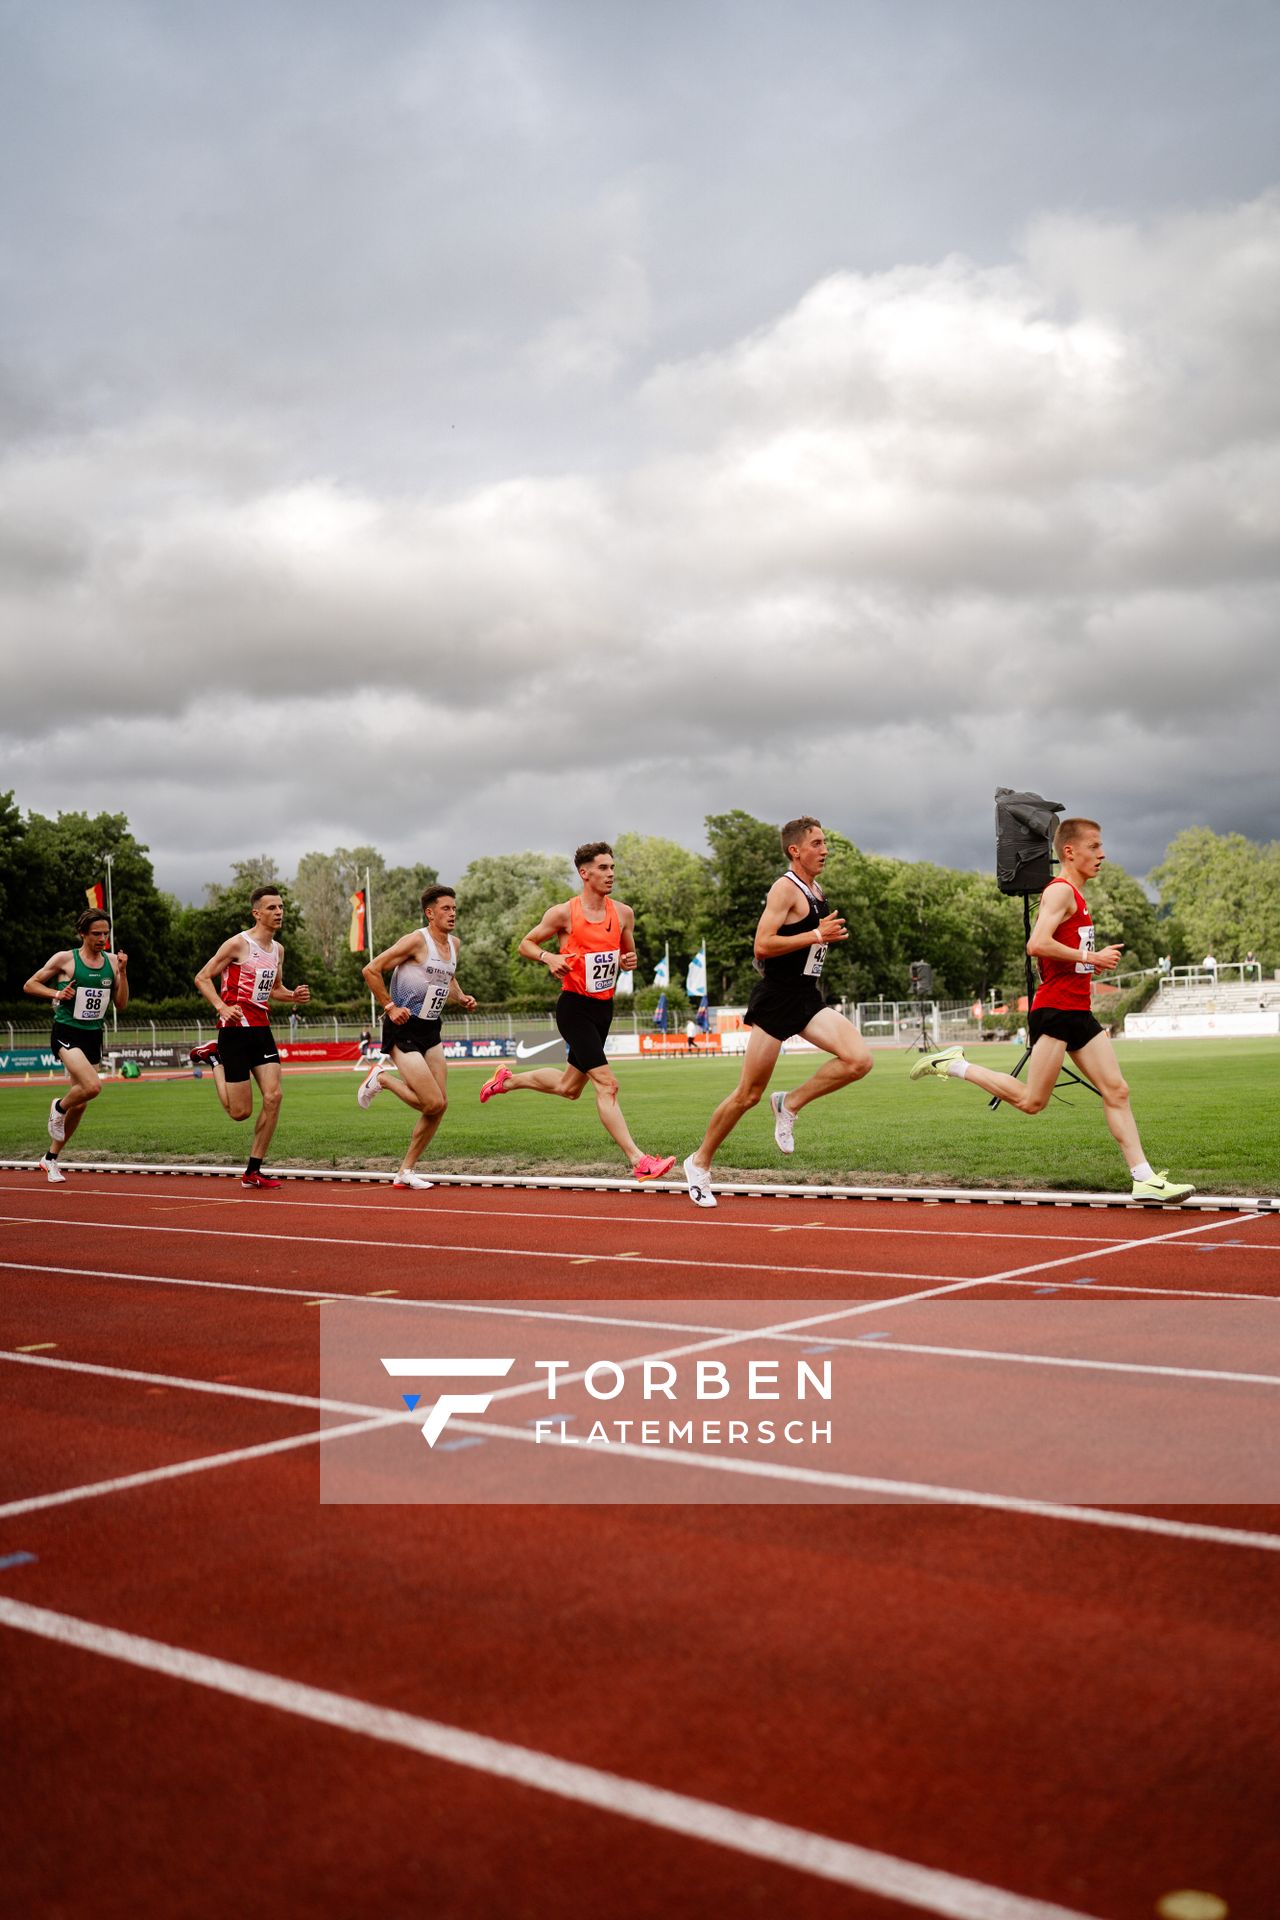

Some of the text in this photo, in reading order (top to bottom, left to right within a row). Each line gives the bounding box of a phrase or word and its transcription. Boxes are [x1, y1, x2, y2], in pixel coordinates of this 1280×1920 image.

[593, 952, 614, 964] GLS
[262, 970, 275, 979] GLS
[592, 963, 616, 980] 274
[85, 989, 103, 998] GLS
[85, 998, 101, 1010] 88
[121, 1048, 174, 1058] Jetzt App laden!
